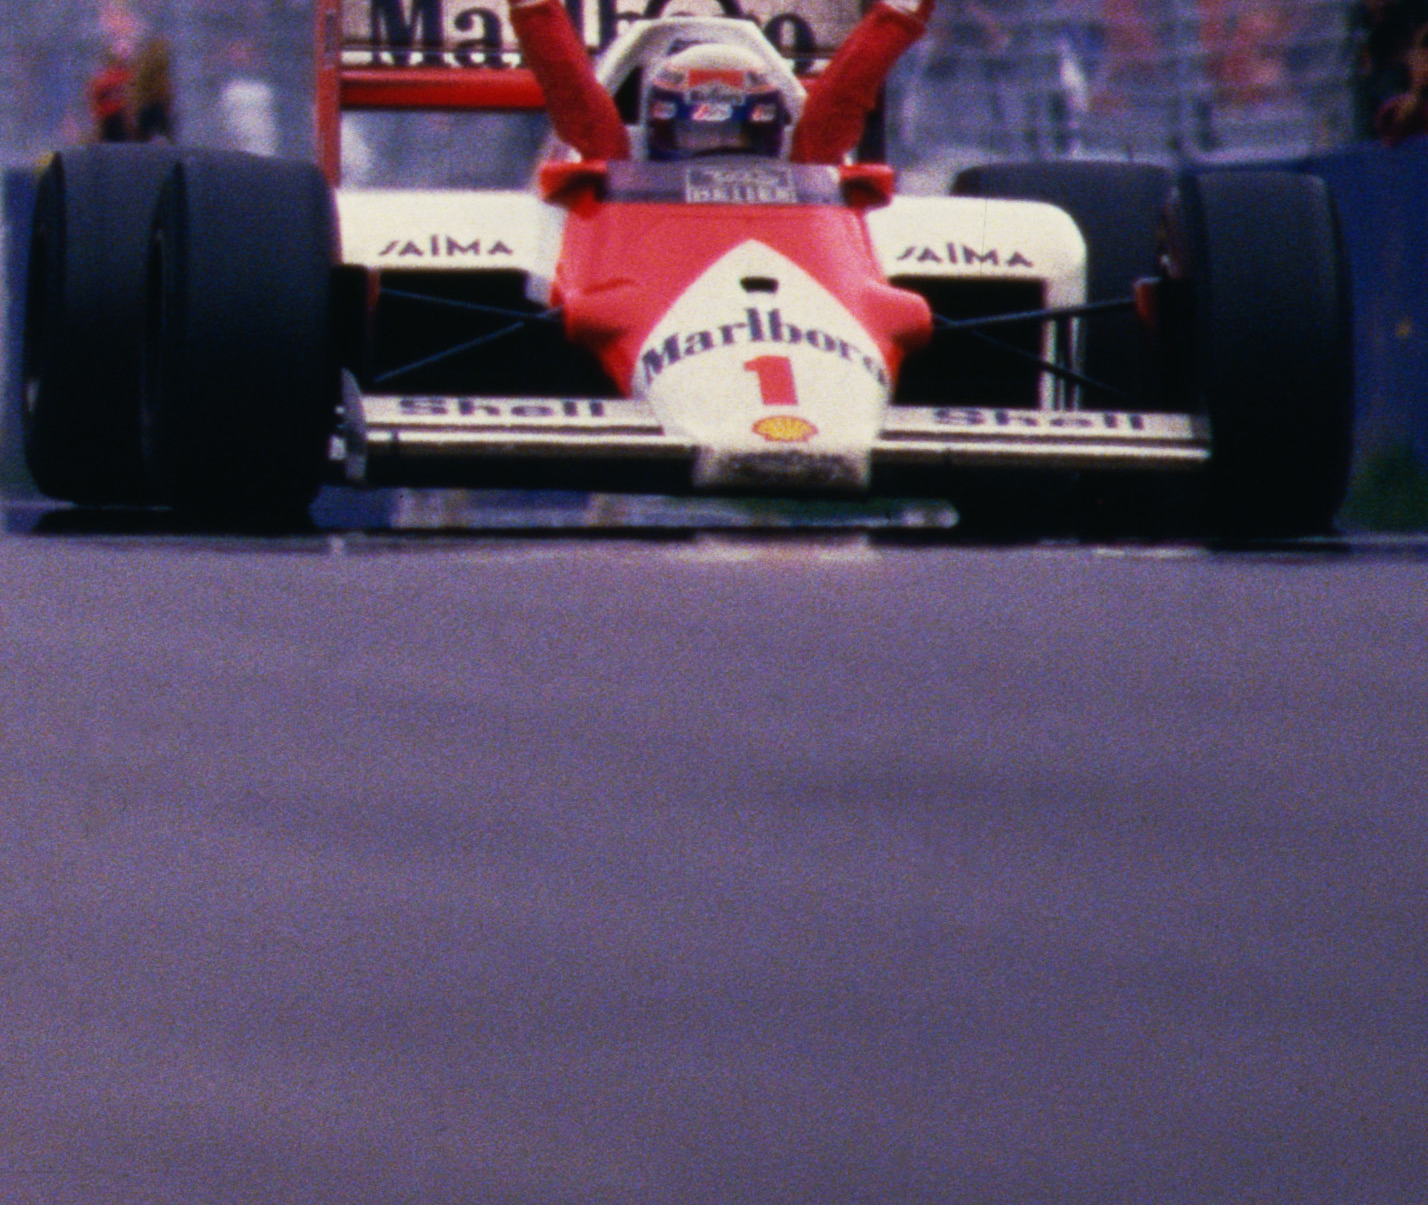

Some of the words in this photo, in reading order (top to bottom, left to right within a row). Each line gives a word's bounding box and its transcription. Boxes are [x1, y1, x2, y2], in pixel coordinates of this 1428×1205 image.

[642, 306, 889, 388] Marlboro
[743, 354, 799, 407] 1
[399, 397, 606, 417] Shell
[934, 408, 1144, 431] Shell
